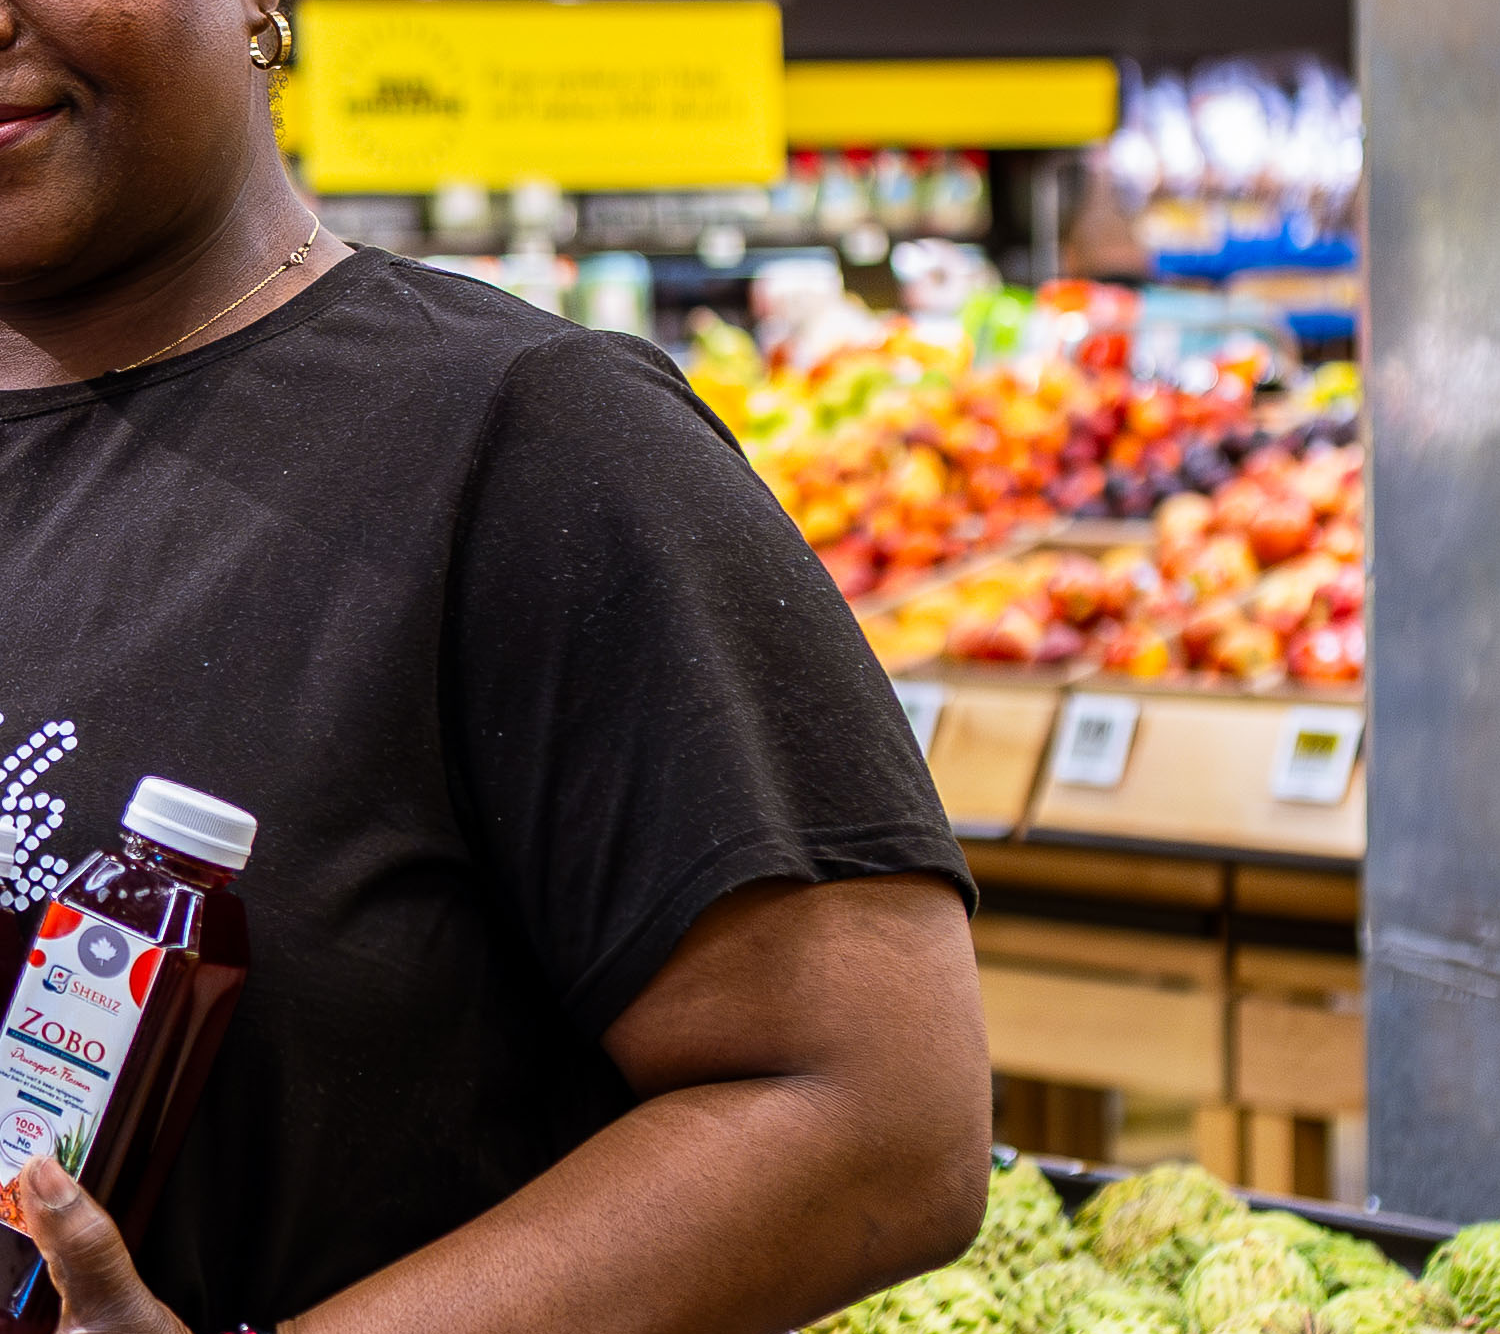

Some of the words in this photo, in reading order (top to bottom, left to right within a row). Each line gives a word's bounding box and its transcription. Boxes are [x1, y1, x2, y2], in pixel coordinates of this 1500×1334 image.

[70, 981, 121, 1013] SHERIZ
[18, 1007, 105, 1063] ZOBO
[15, 1117, 44, 1137] 100%
[17, 1136, 31, 1149] No
